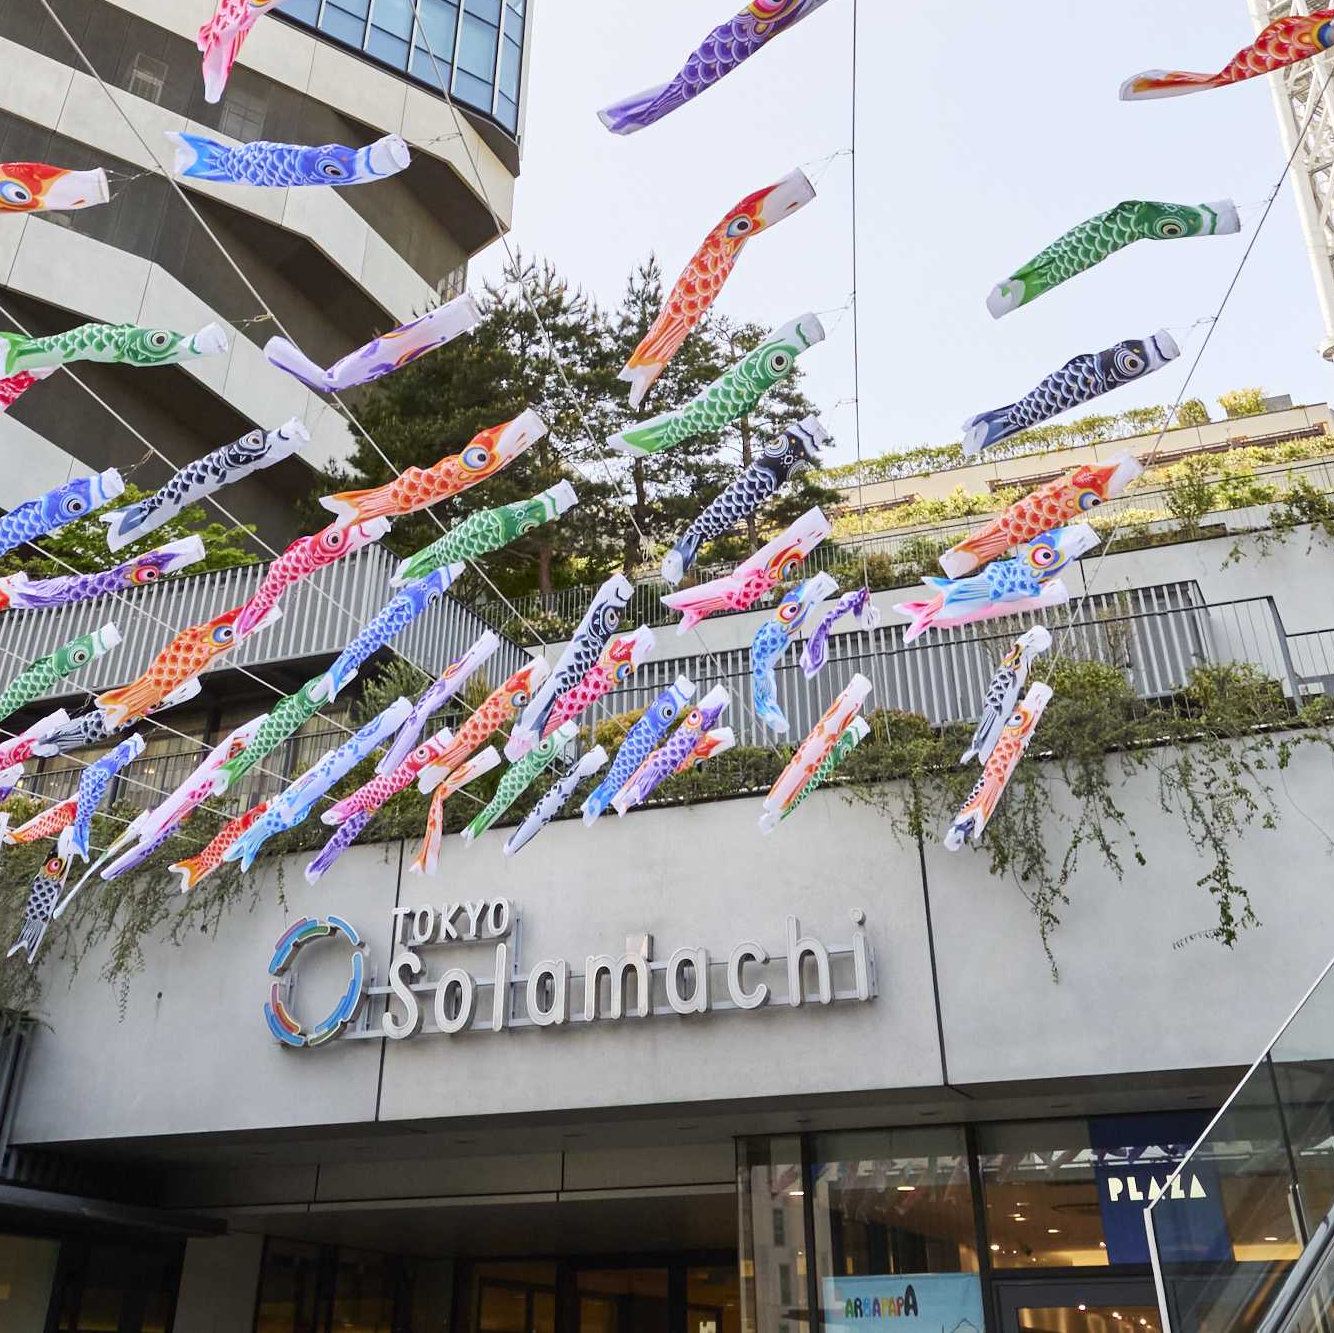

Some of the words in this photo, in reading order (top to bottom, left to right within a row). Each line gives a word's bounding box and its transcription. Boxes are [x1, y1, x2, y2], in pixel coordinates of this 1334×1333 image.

[393, 897, 513, 942] TOKYO
[382, 907, 872, 1039] Solamachi
[1107, 1174, 1207, 1202] PLAZA
